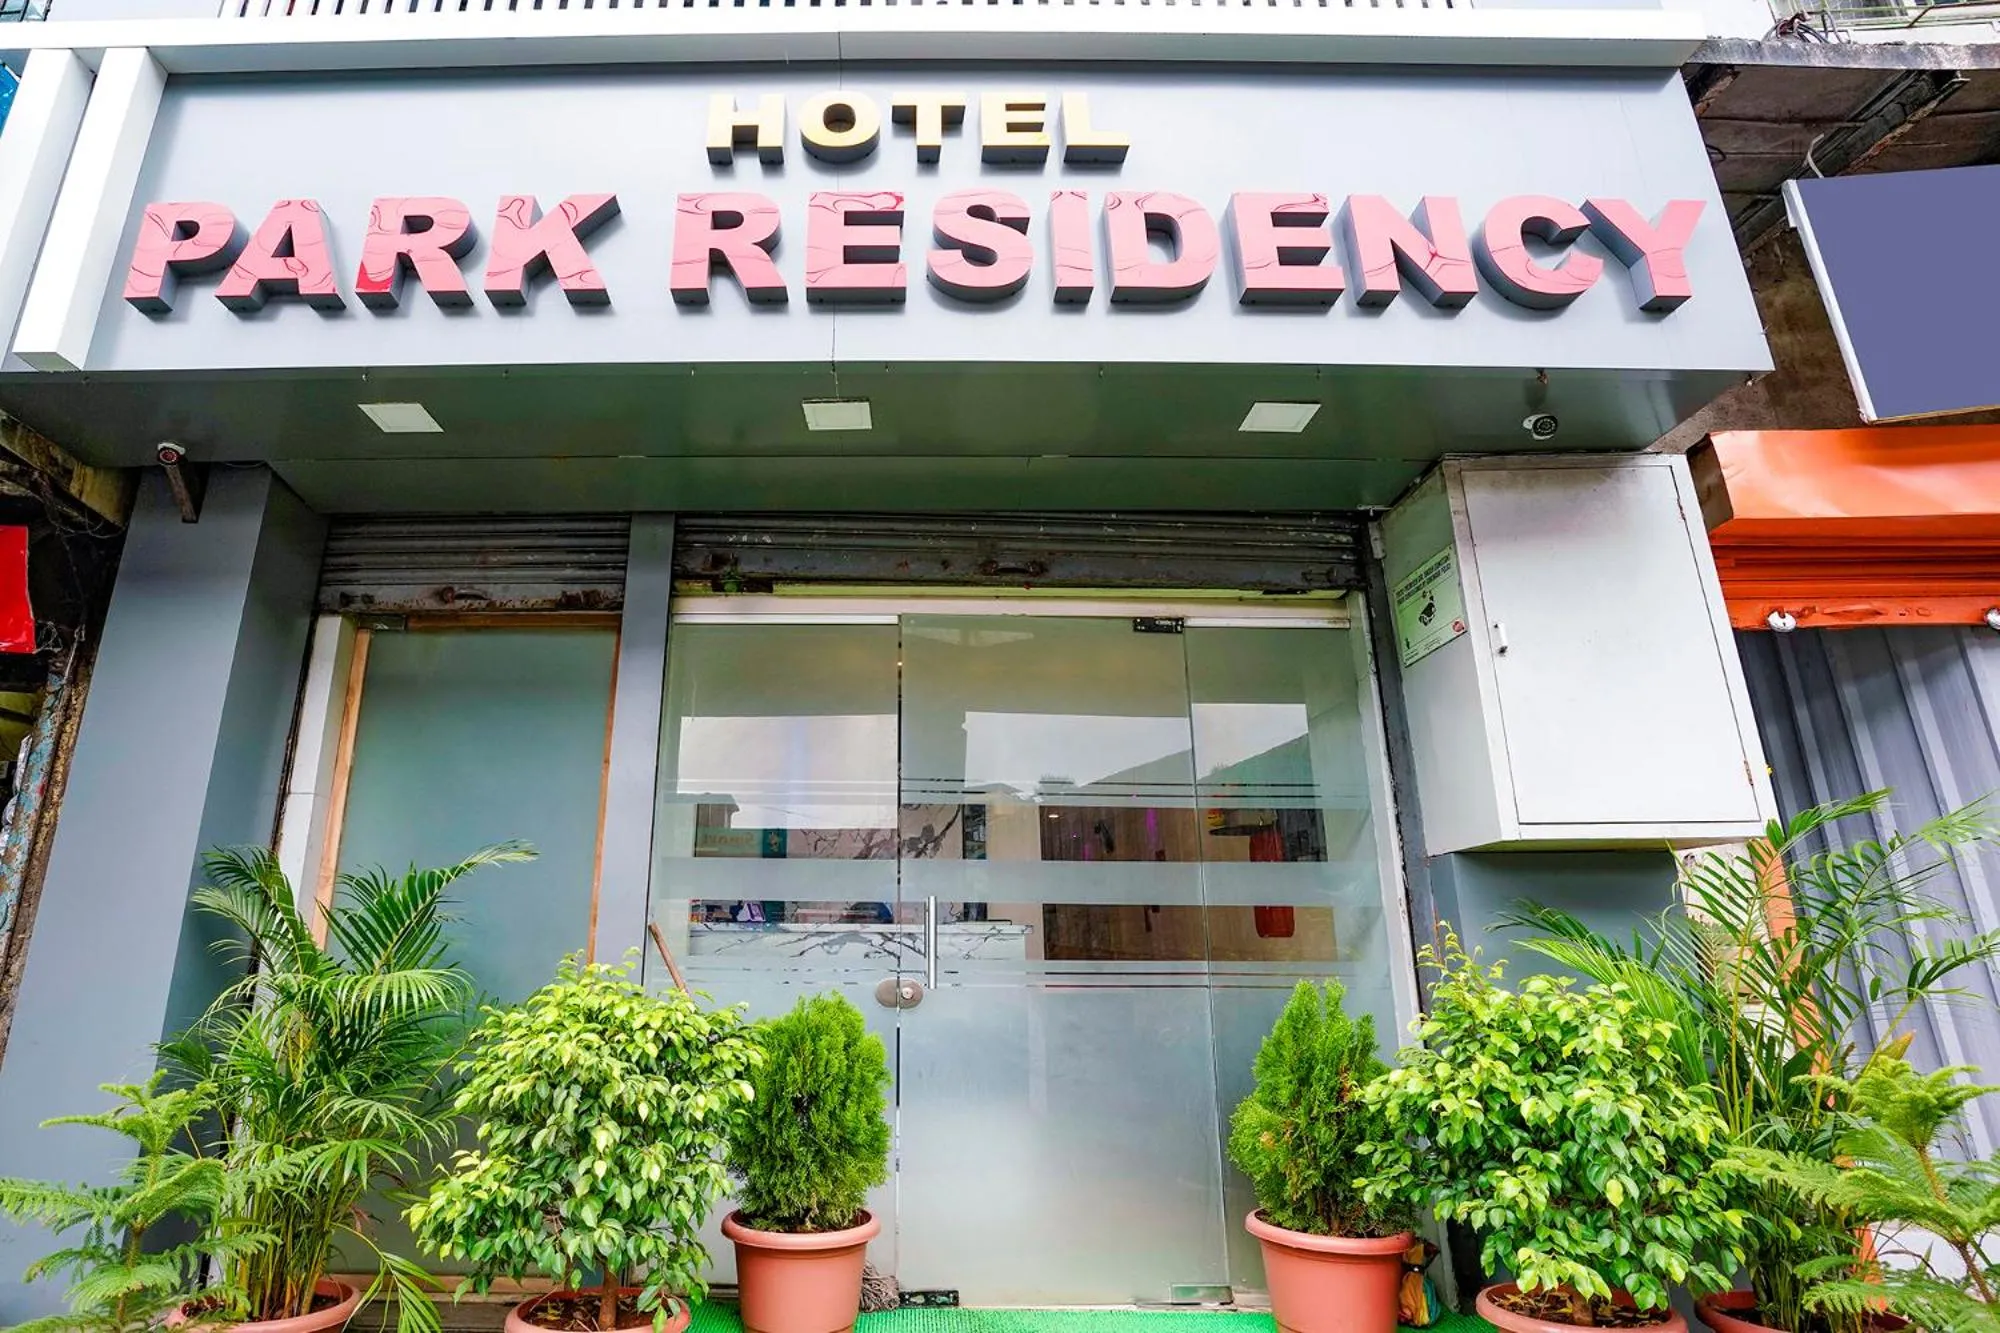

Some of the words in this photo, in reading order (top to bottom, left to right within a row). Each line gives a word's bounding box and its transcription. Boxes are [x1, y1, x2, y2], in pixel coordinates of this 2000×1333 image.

[707, 91, 1130, 164] HOTEL
[124, 194, 621, 312] PARK
[670, 191, 1706, 312] RESIDENCY
